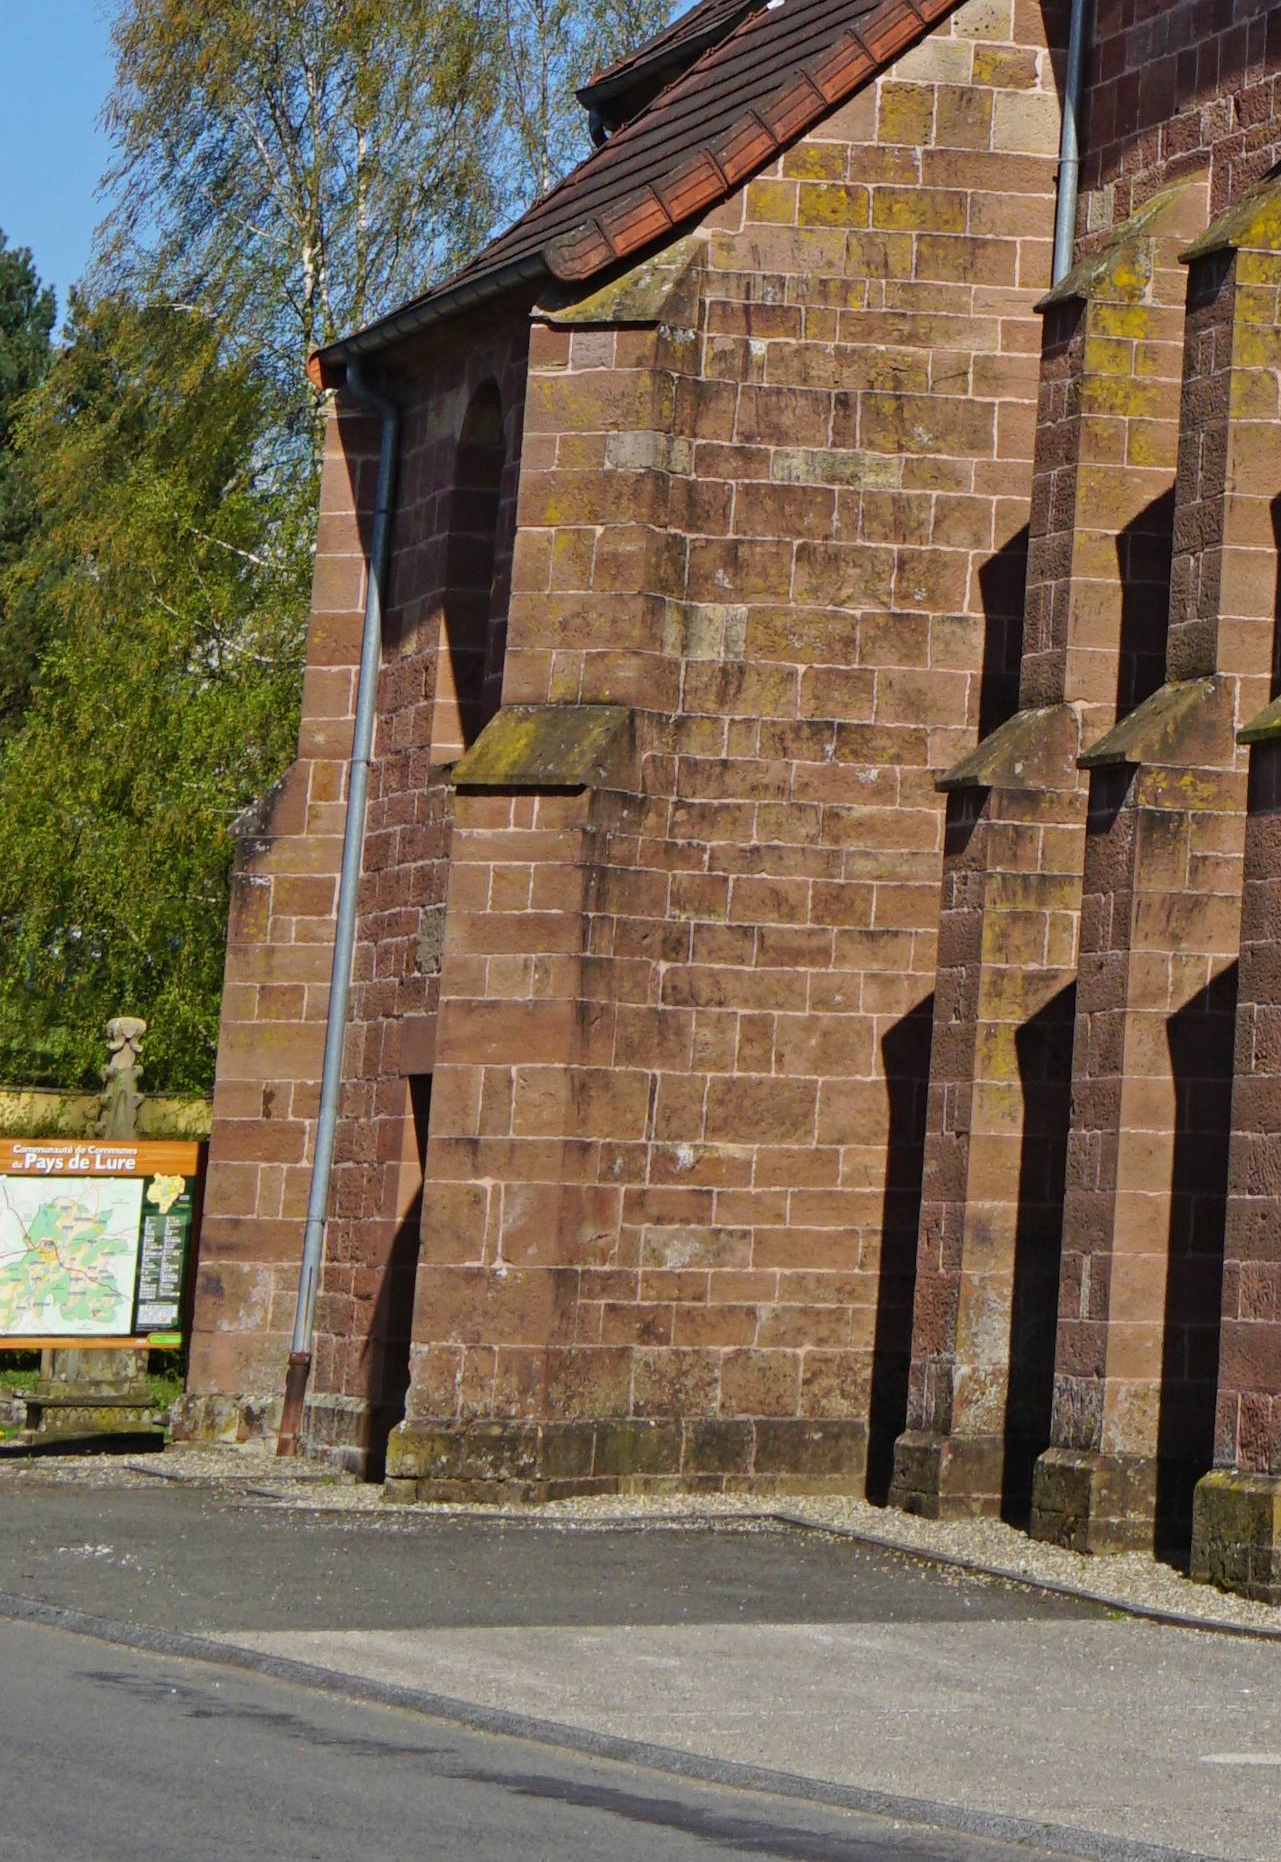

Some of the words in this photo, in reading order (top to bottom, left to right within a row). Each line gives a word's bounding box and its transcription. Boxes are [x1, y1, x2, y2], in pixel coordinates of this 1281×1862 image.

[13, 1145, 73, 1154] Communauté
[75, 1146, 86, 1154] de
[88, 1146, 137, 1155] Communes
[24, 1153, 64, 1173] Pays
[68, 1154, 90, 1170] de
[94, 1155, 136, 1170] Lure
